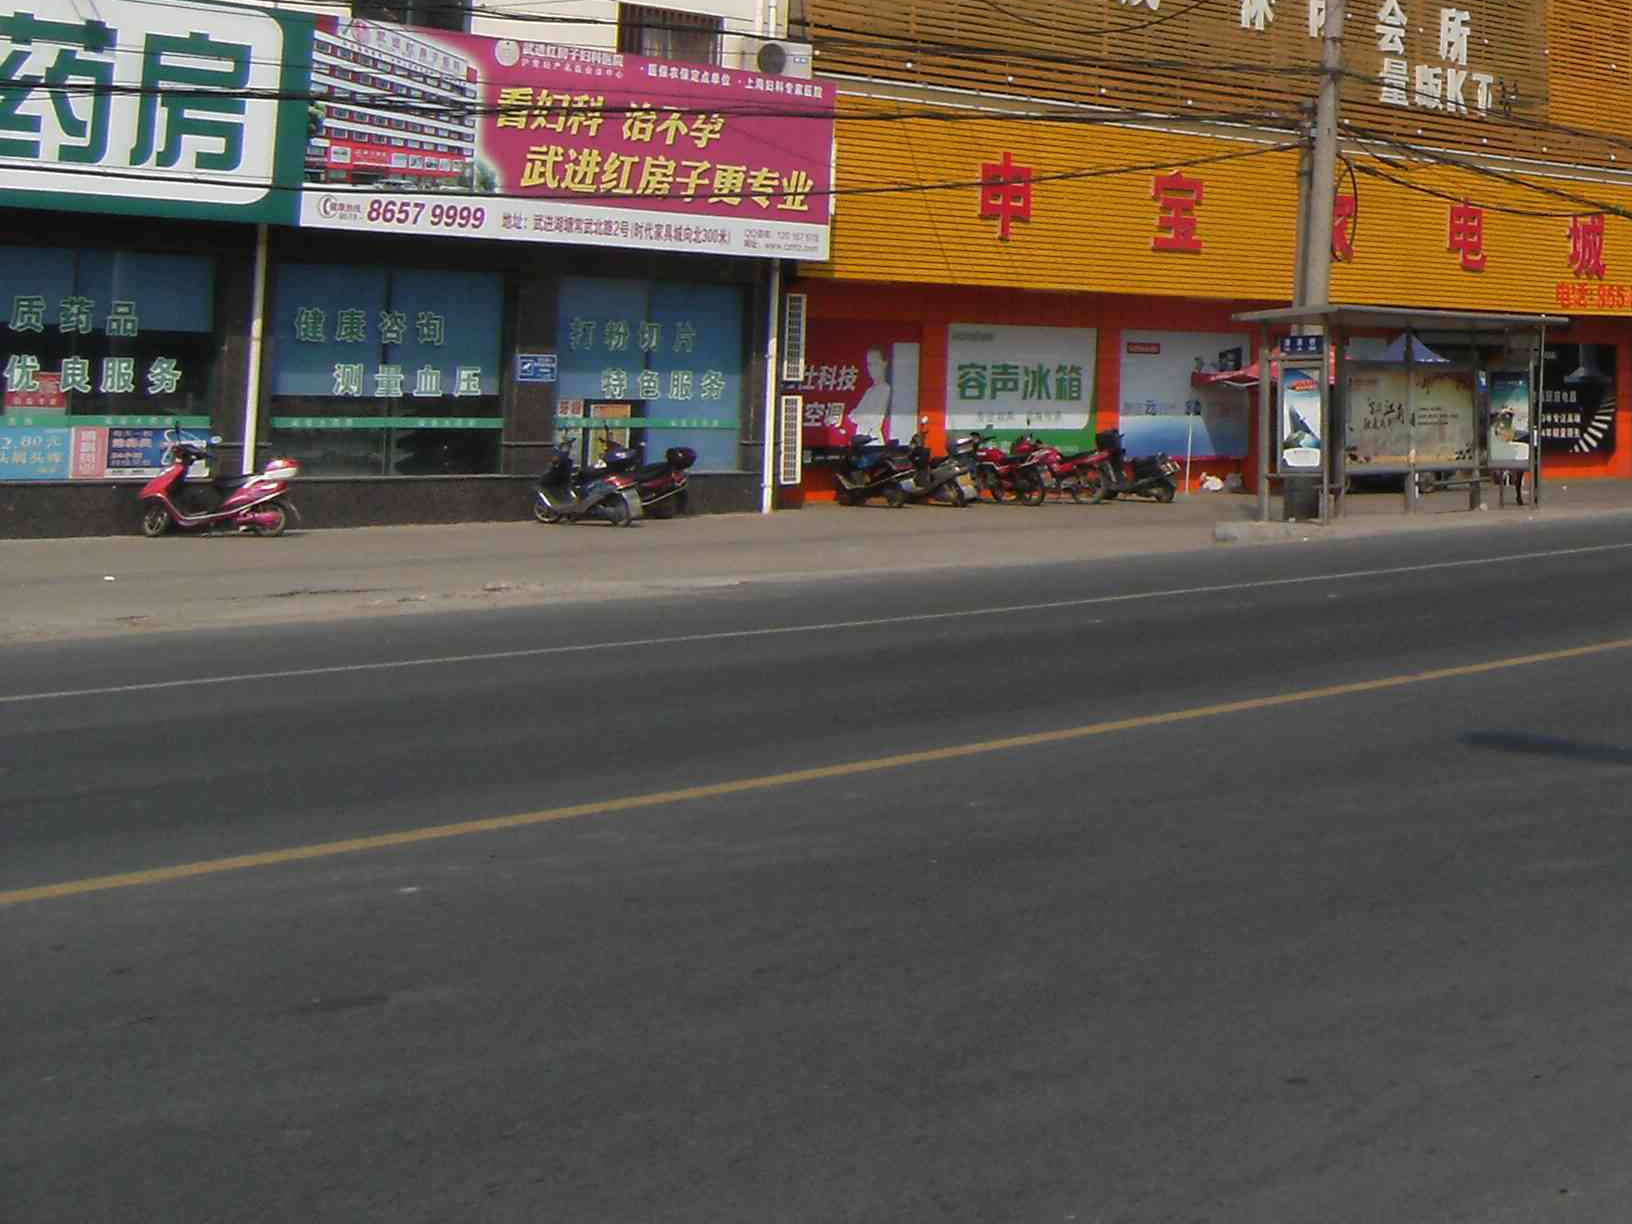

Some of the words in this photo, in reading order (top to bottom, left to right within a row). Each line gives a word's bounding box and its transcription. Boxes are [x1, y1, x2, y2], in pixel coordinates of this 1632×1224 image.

[0, 12, 253, 172] 药房
[497, 87, 605, 137] 看妇科
[620, 101, 726, 149] 治不孕
[519, 144, 815, 213] 武进红房子更专业
[367, 199, 426, 226] 8657
[430, 203, 487, 230] 9999
[8, 295, 139, 338] 质药品
[294, 306, 446, 346] 健康咨询
[4, 354, 183, 395] 优良服务
[331, 362, 482, 398] 测量血压
[602, 368, 726, 401] 特色服务
[957, 362, 1084, 402] 容声冰箱
[803, 402, 846, 428] 空调
